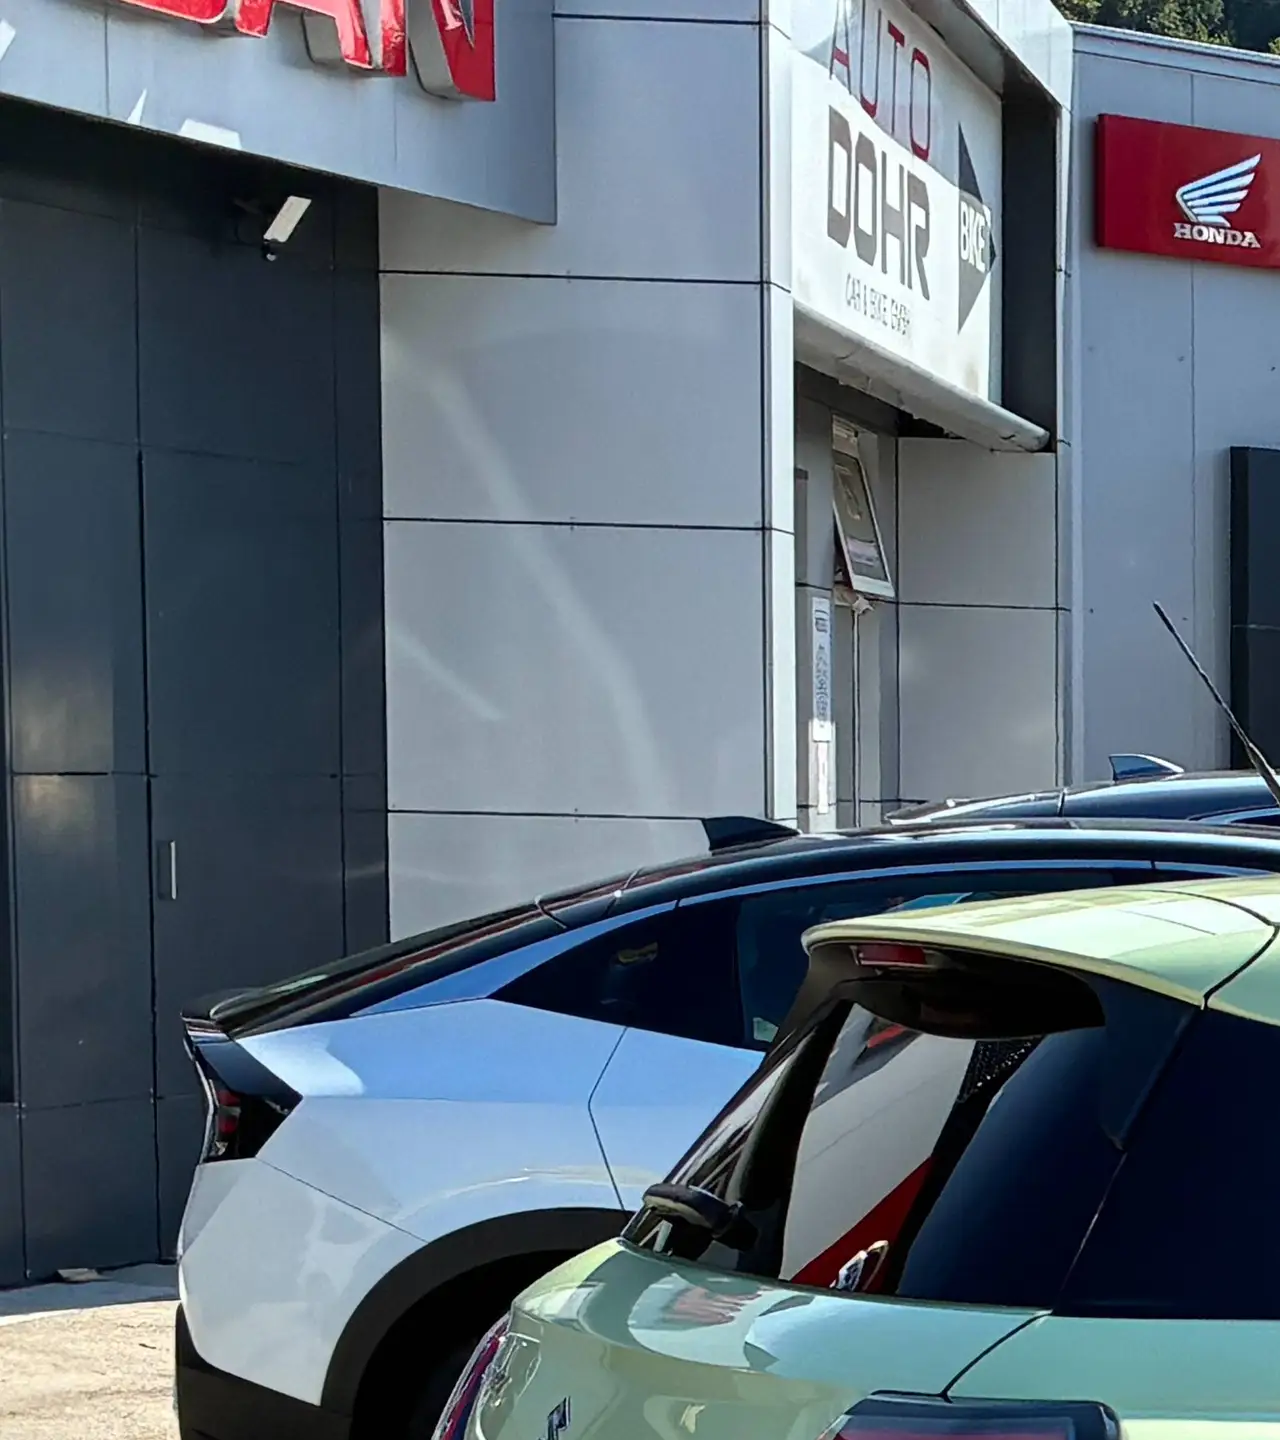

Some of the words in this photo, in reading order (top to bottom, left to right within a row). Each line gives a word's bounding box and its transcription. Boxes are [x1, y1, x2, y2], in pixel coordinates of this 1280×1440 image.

[829, 0, 931, 162] AUTO
[827, 104, 930, 301] DOHR
[1173, 221, 1261, 249] HONDA
